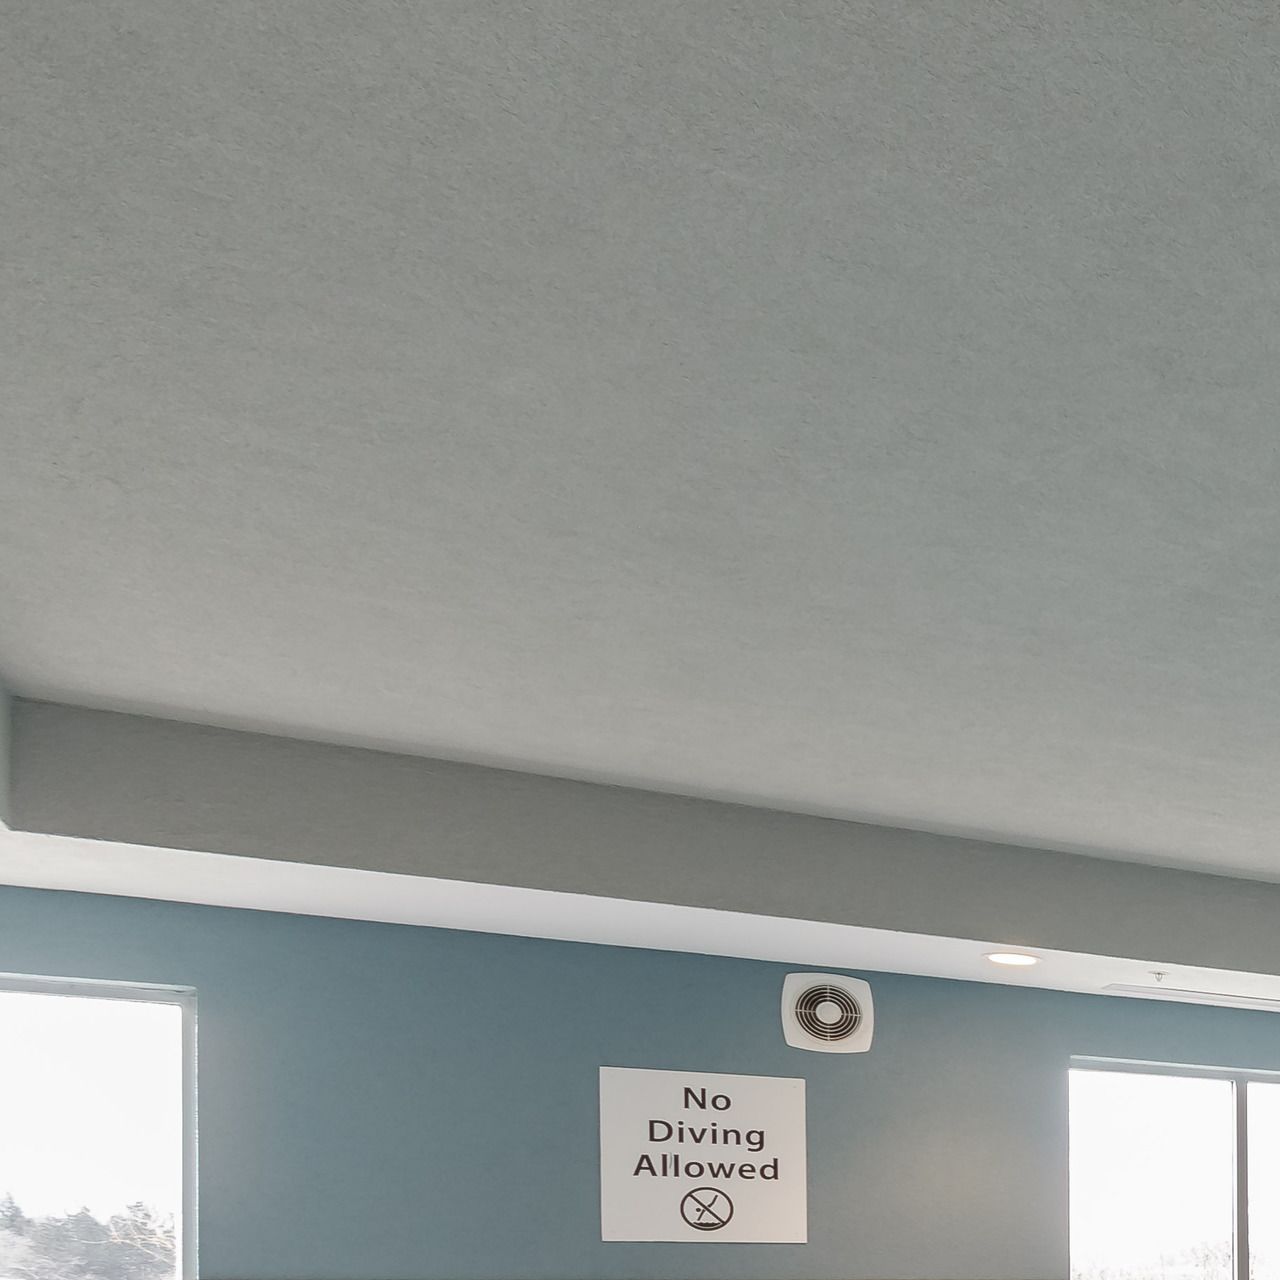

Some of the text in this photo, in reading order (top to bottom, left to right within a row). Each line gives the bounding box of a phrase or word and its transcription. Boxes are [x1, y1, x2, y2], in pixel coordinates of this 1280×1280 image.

[684, 1087, 731, 1110] No
[648, 1120, 765, 1152] Diving
[633, 1154, 779, 1180] Allowed
